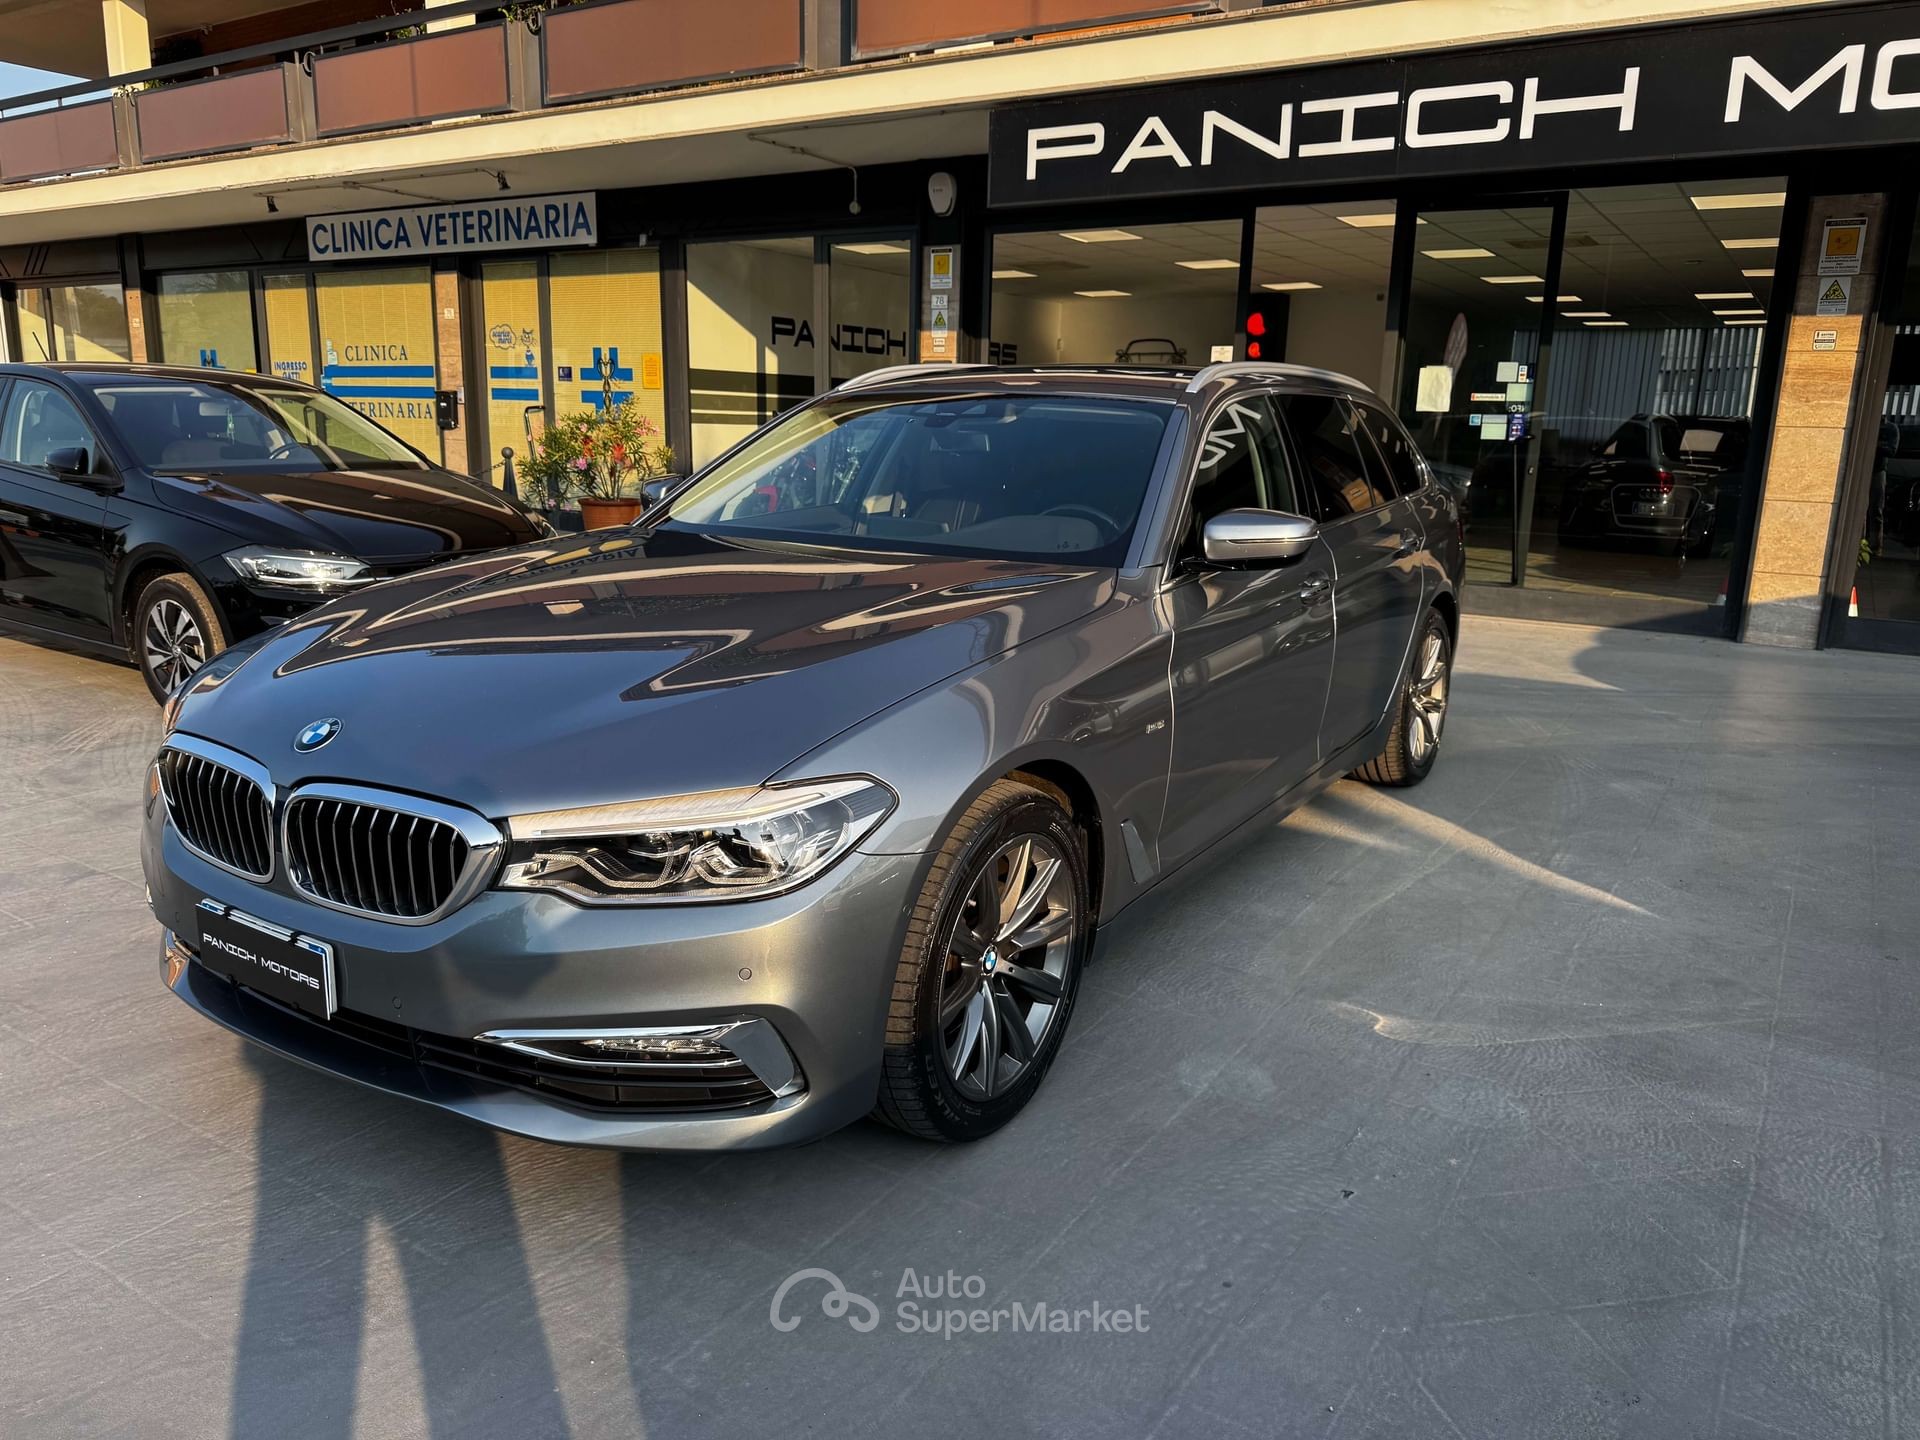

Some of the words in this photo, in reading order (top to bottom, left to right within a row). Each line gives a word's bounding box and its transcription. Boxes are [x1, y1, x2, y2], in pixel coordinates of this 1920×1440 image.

[1026, 66, 1640, 180] PANICH
[312, 217, 411, 254] CLINICA
[417, 201, 592, 247] VETERINARIA
[274, 361, 307, 371] INGRESSO
[345, 344, 408, 361] CLINICA
[203, 933, 257, 963] PANICH
[261, 957, 320, 990] MOTORS
